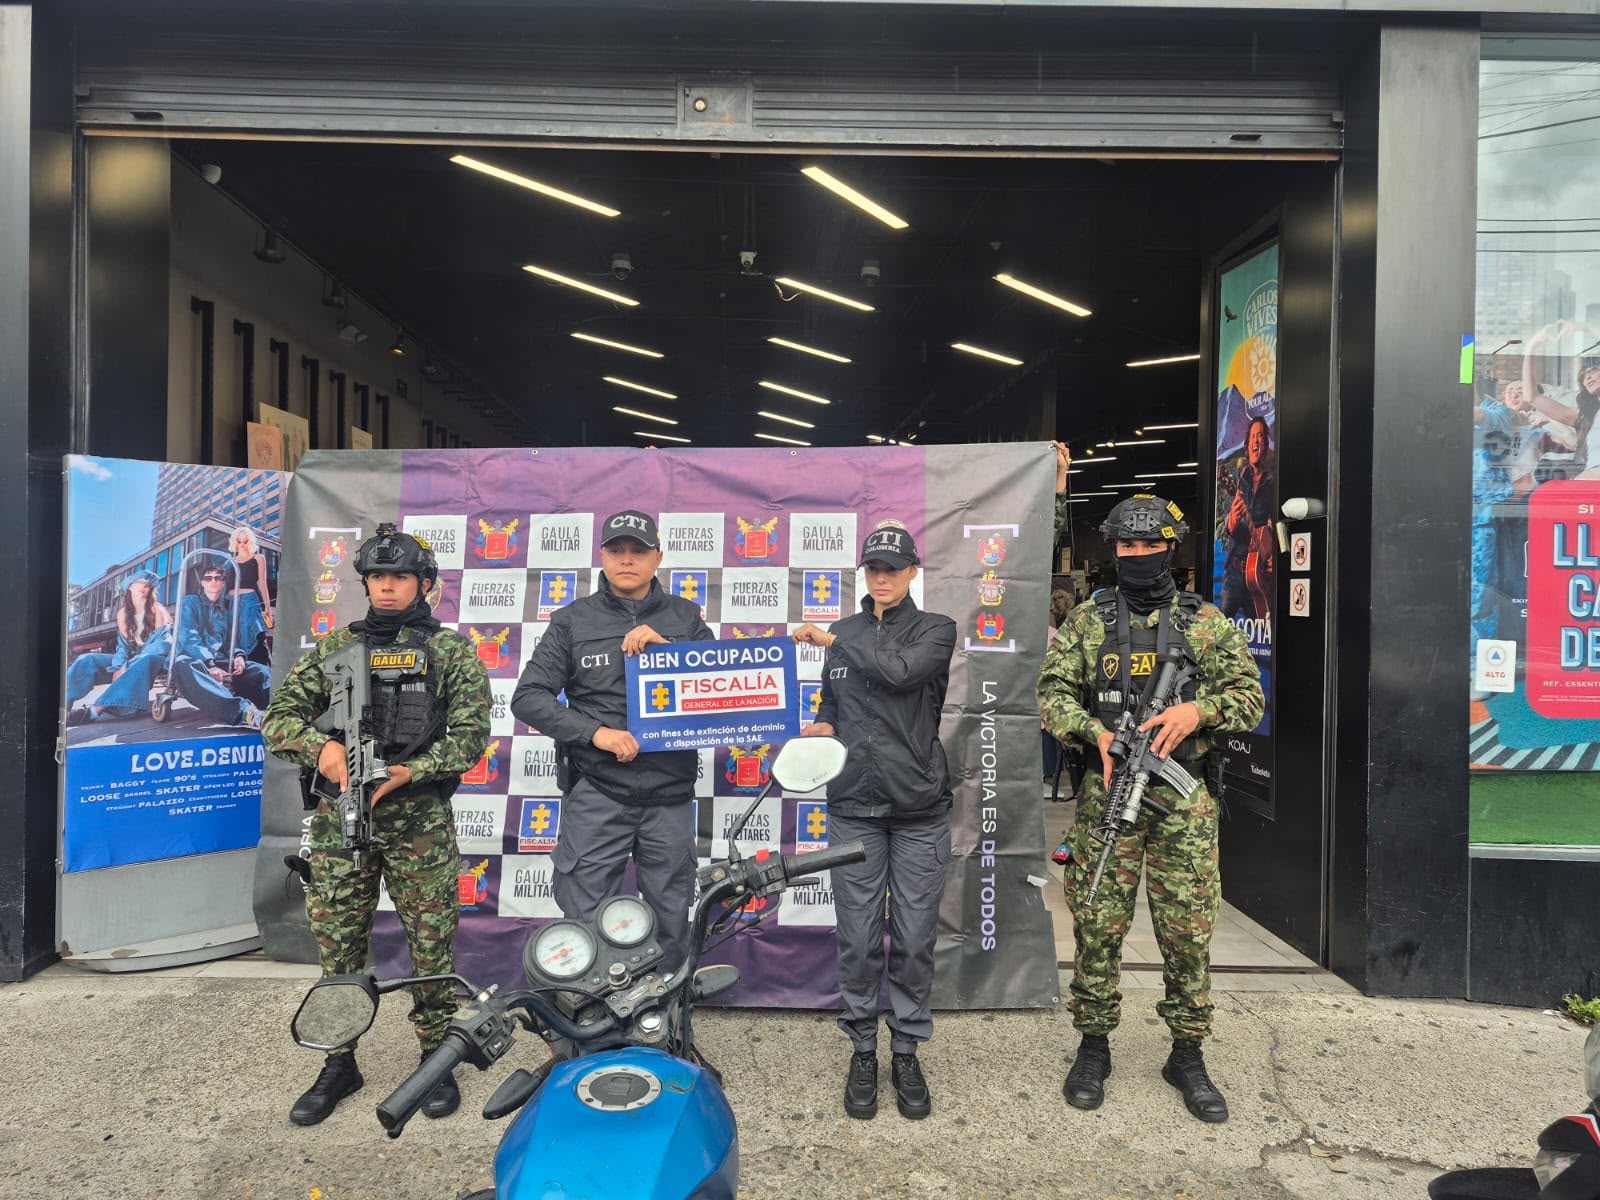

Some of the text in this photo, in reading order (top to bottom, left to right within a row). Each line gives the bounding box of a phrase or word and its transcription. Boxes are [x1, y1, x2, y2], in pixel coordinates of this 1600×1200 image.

[1577, 504, 1595, 514] SI
[610, 514, 648, 533] CTI
[541, 526, 580, 539] GAULA
[669, 527, 713, 539] FUERZAS
[802, 526, 844, 539] GAULA
[540, 539, 580, 552] MILITAR
[667, 540, 714, 552] MILITARES
[802, 539, 844, 551] MILITAR
[866, 531, 903, 548] CTI
[430, 541, 456, 554] TARES
[471, 583, 516, 594] FUERZAS
[733, 582, 778, 594] FUERZAS
[468, 595, 516, 607] MILITARES
[731, 595, 779, 608] MILITARES
[373, 654, 413, 667] GAULA
[580, 653, 611, 669] CTI
[639, 646, 783, 669] BIEN OCUPADO
[829, 667, 849, 680] CTI
[680, 671, 777, 694] FISCALÍA
[684, 701, 722, 710] GENERAL
[723, 700, 734, 708] DE
[642, 722, 786, 740] con fines de extinción de dominio
[673, 736, 722, 749] disposición
[722, 735, 735, 744] de
[1228, 738, 1251, 754] KOAJ
[524, 750, 556, 764] GAUL
[523, 764, 558, 778] MILITA
[110, 780, 147, 789] BAGGY
[233, 769, 264, 777] PALAZ
[80, 791, 121, 803] LOOSE
[155, 784, 201, 796] SKATER
[138, 798, 185, 809] PALAZZO
[168, 804, 213, 816] SKATER
[980, 681, 998, 951] LA VICTORIA ES DE TODOS
[456, 824, 494, 837] LITARES
